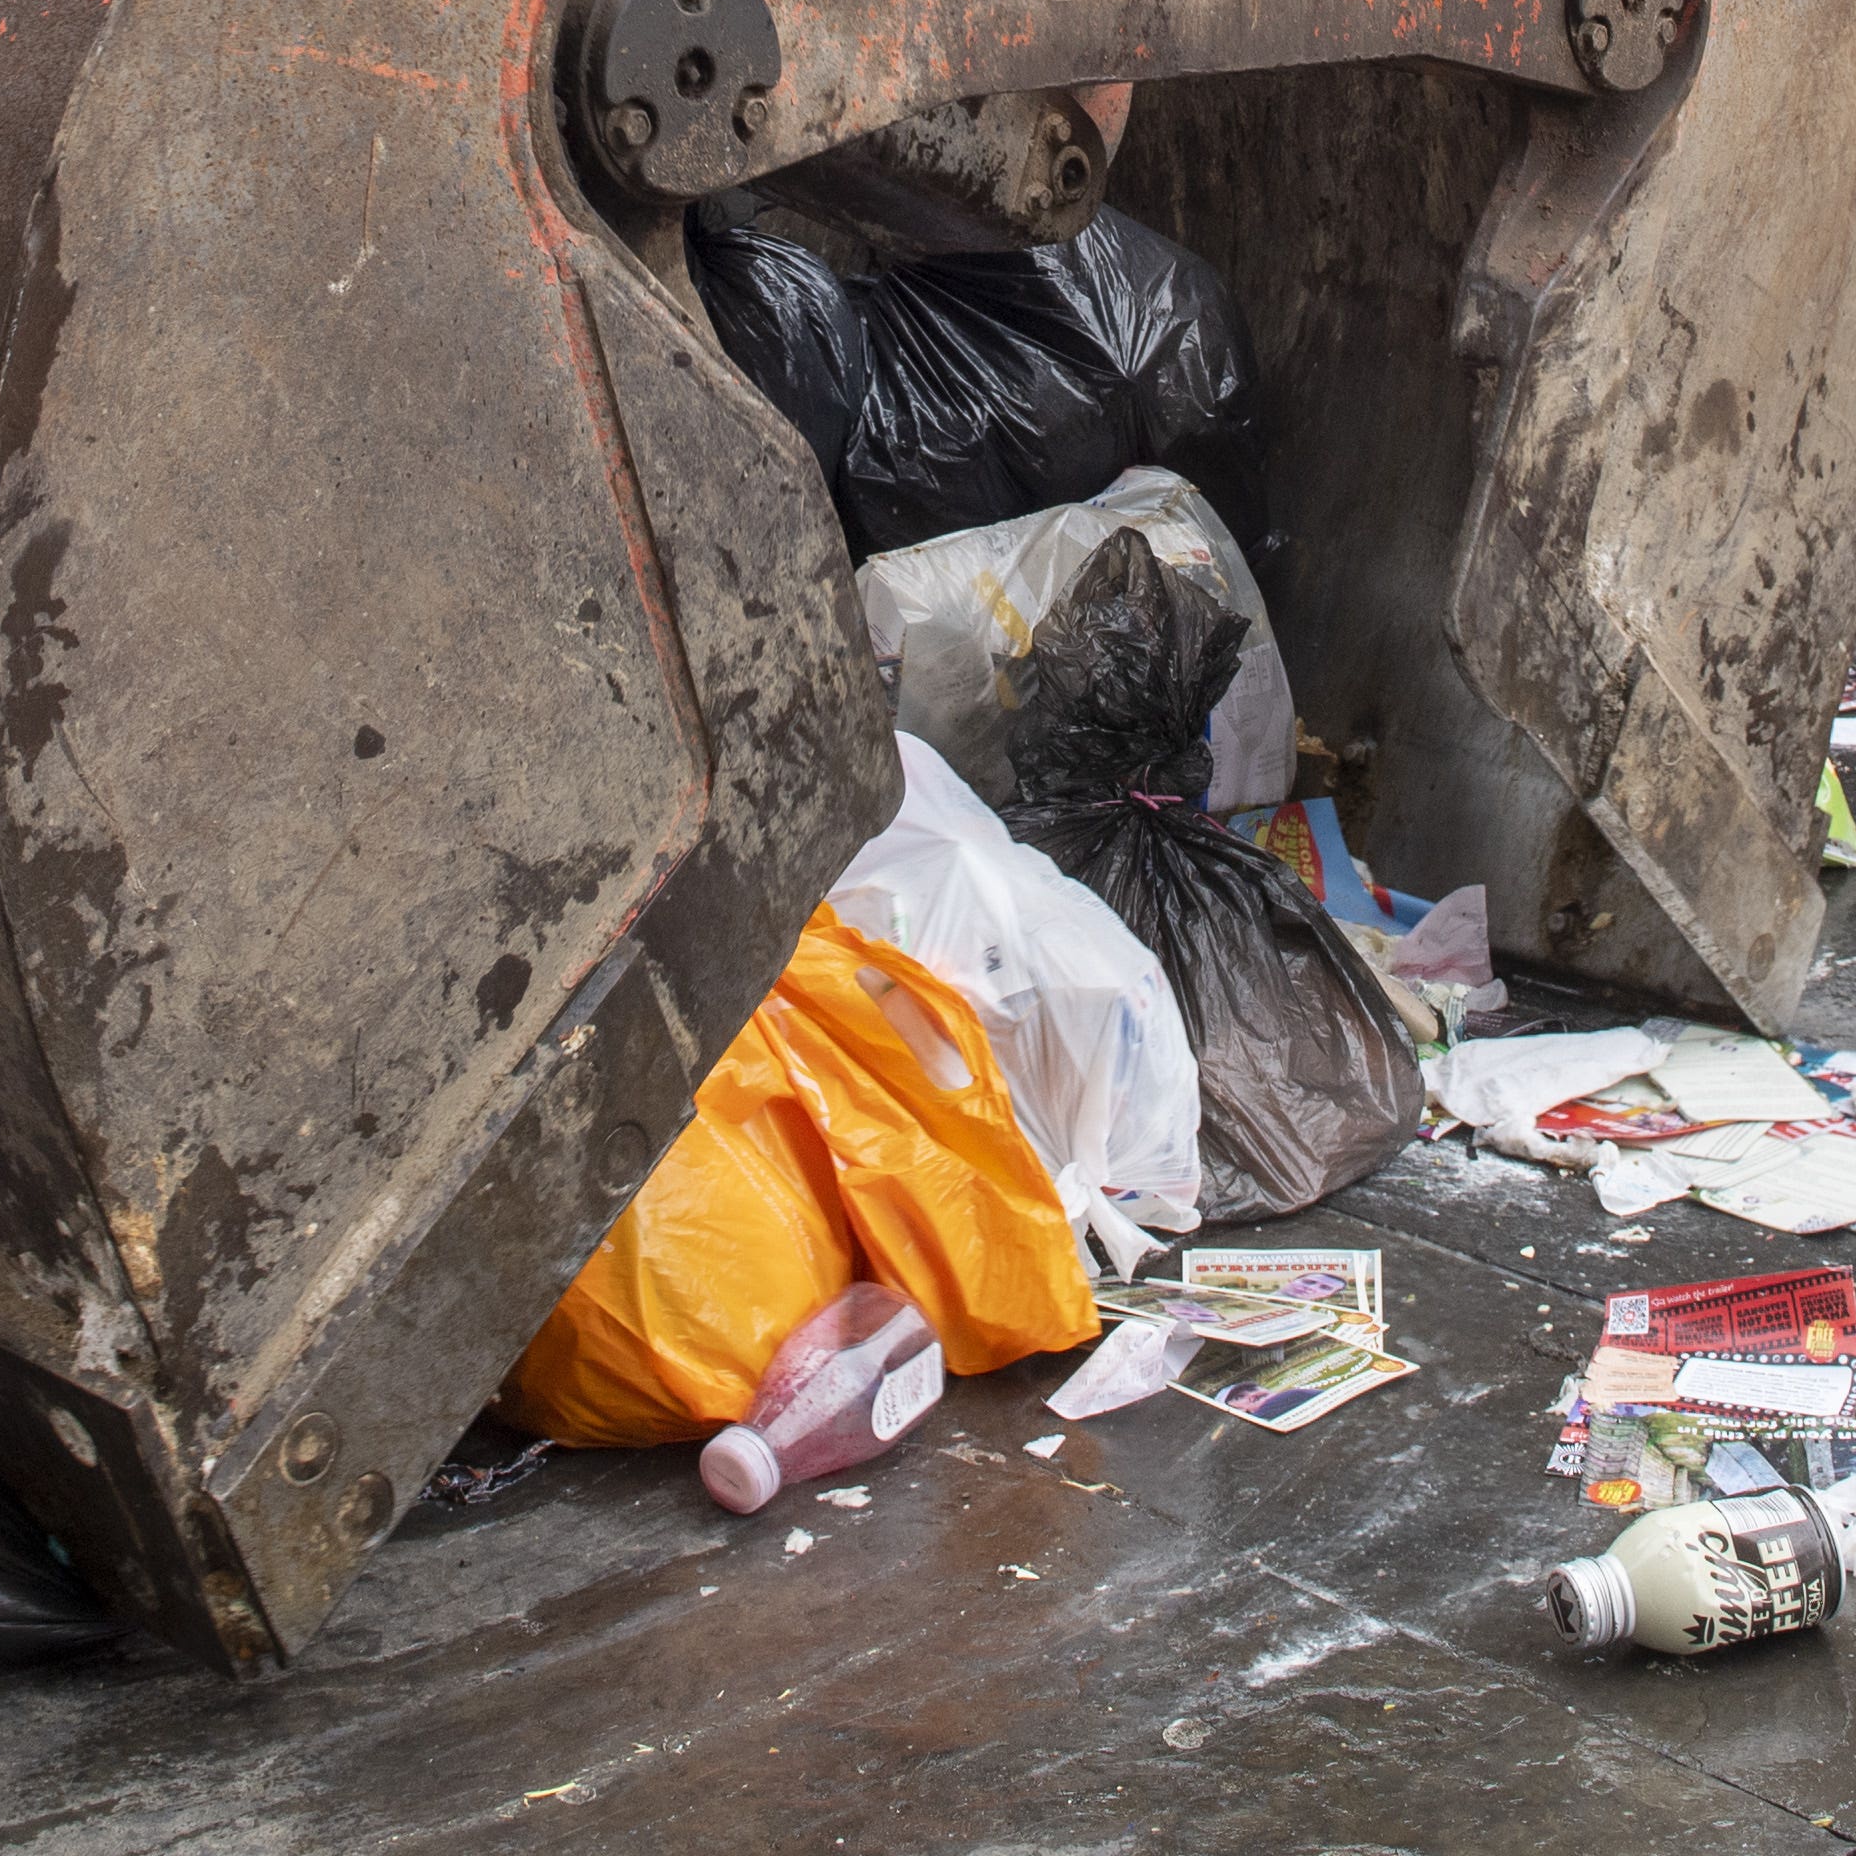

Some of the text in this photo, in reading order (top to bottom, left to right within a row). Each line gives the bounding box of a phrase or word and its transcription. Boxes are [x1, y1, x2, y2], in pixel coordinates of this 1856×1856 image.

[1693, 1289, 1706, 1301] the
[1736, 1300, 1789, 1318] GANGSTER
[1737, 1310, 1791, 1329] HOT DOG
[1740, 1321, 1793, 1337] VENDORS
[1807, 1324, 1836, 1342] FREE
[1697, 1416, 1743, 1428] me?
[1677, 1426, 1698, 1436] in
[1703, 1428, 1745, 1440] this
[1792, 1429, 1835, 1440] you
[1758, 1534, 1802, 1633] FFEE
